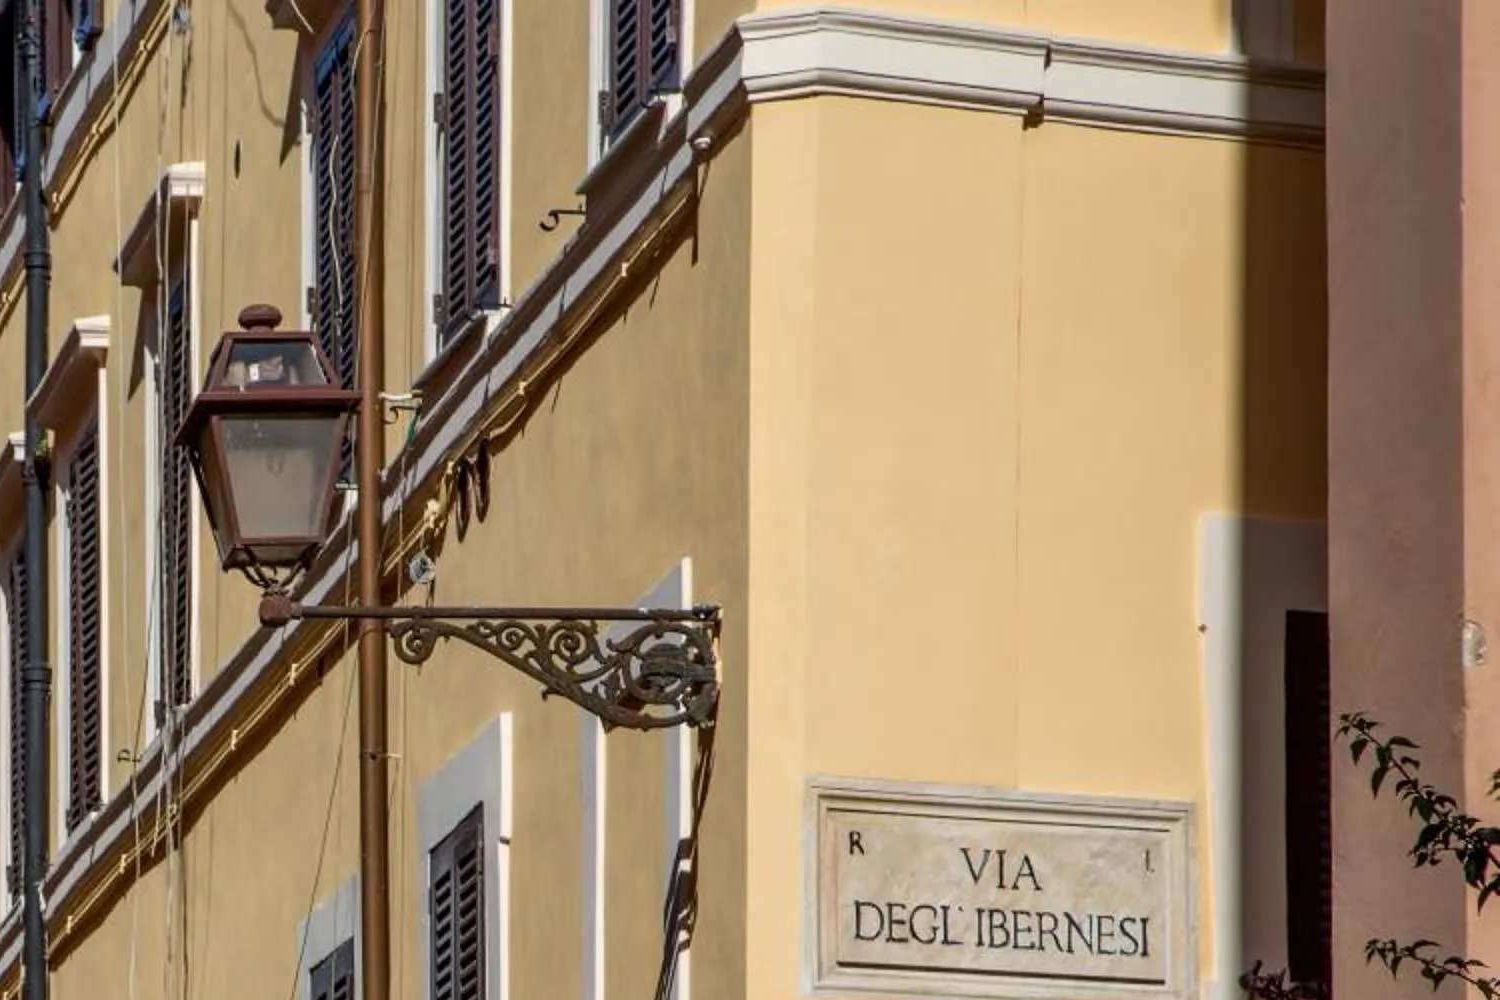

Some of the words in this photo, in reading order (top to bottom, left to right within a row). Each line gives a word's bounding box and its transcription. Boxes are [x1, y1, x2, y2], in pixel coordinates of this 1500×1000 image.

[849, 830, 865, 856] R
[960, 847, 1043, 892] VIA
[975, 907, 1150, 958] IBERNESI
